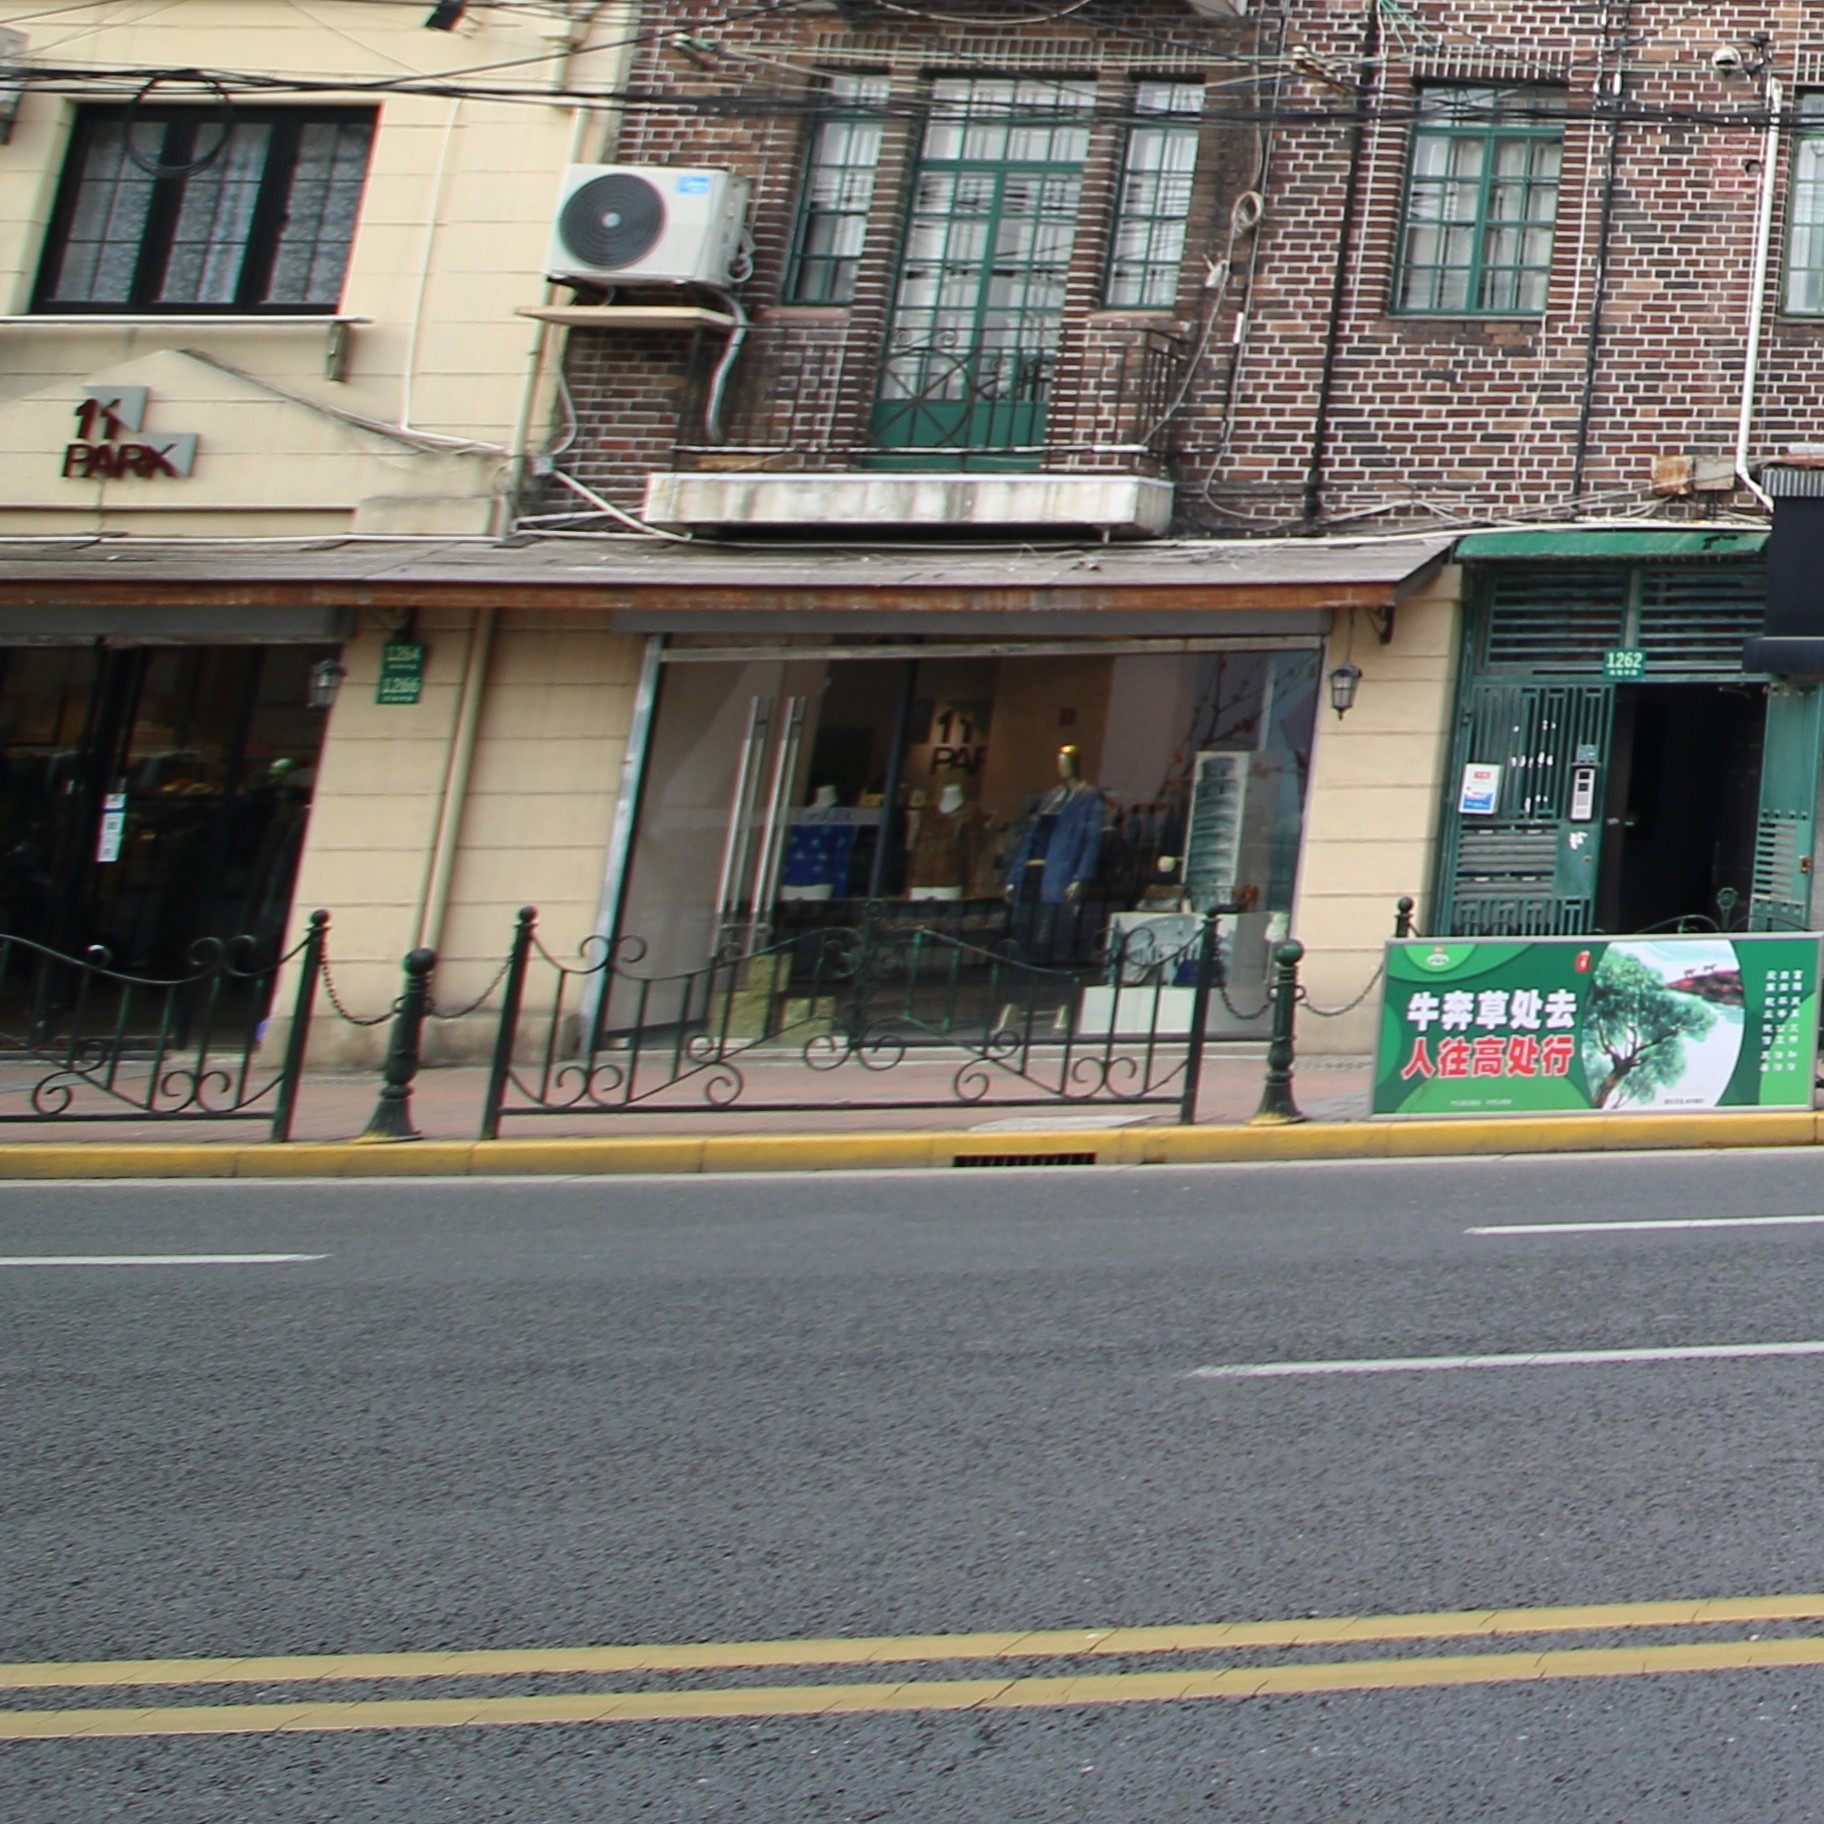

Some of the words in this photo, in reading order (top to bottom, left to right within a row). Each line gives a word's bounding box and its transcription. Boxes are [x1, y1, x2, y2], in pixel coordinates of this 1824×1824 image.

[62, 443, 178, 479] PARK
[1606, 651, 1643, 668] 1262
[1407, 989, 1577, 1032] 牛奔草处去
[1402, 1034, 1575, 1080] 人往高处行
